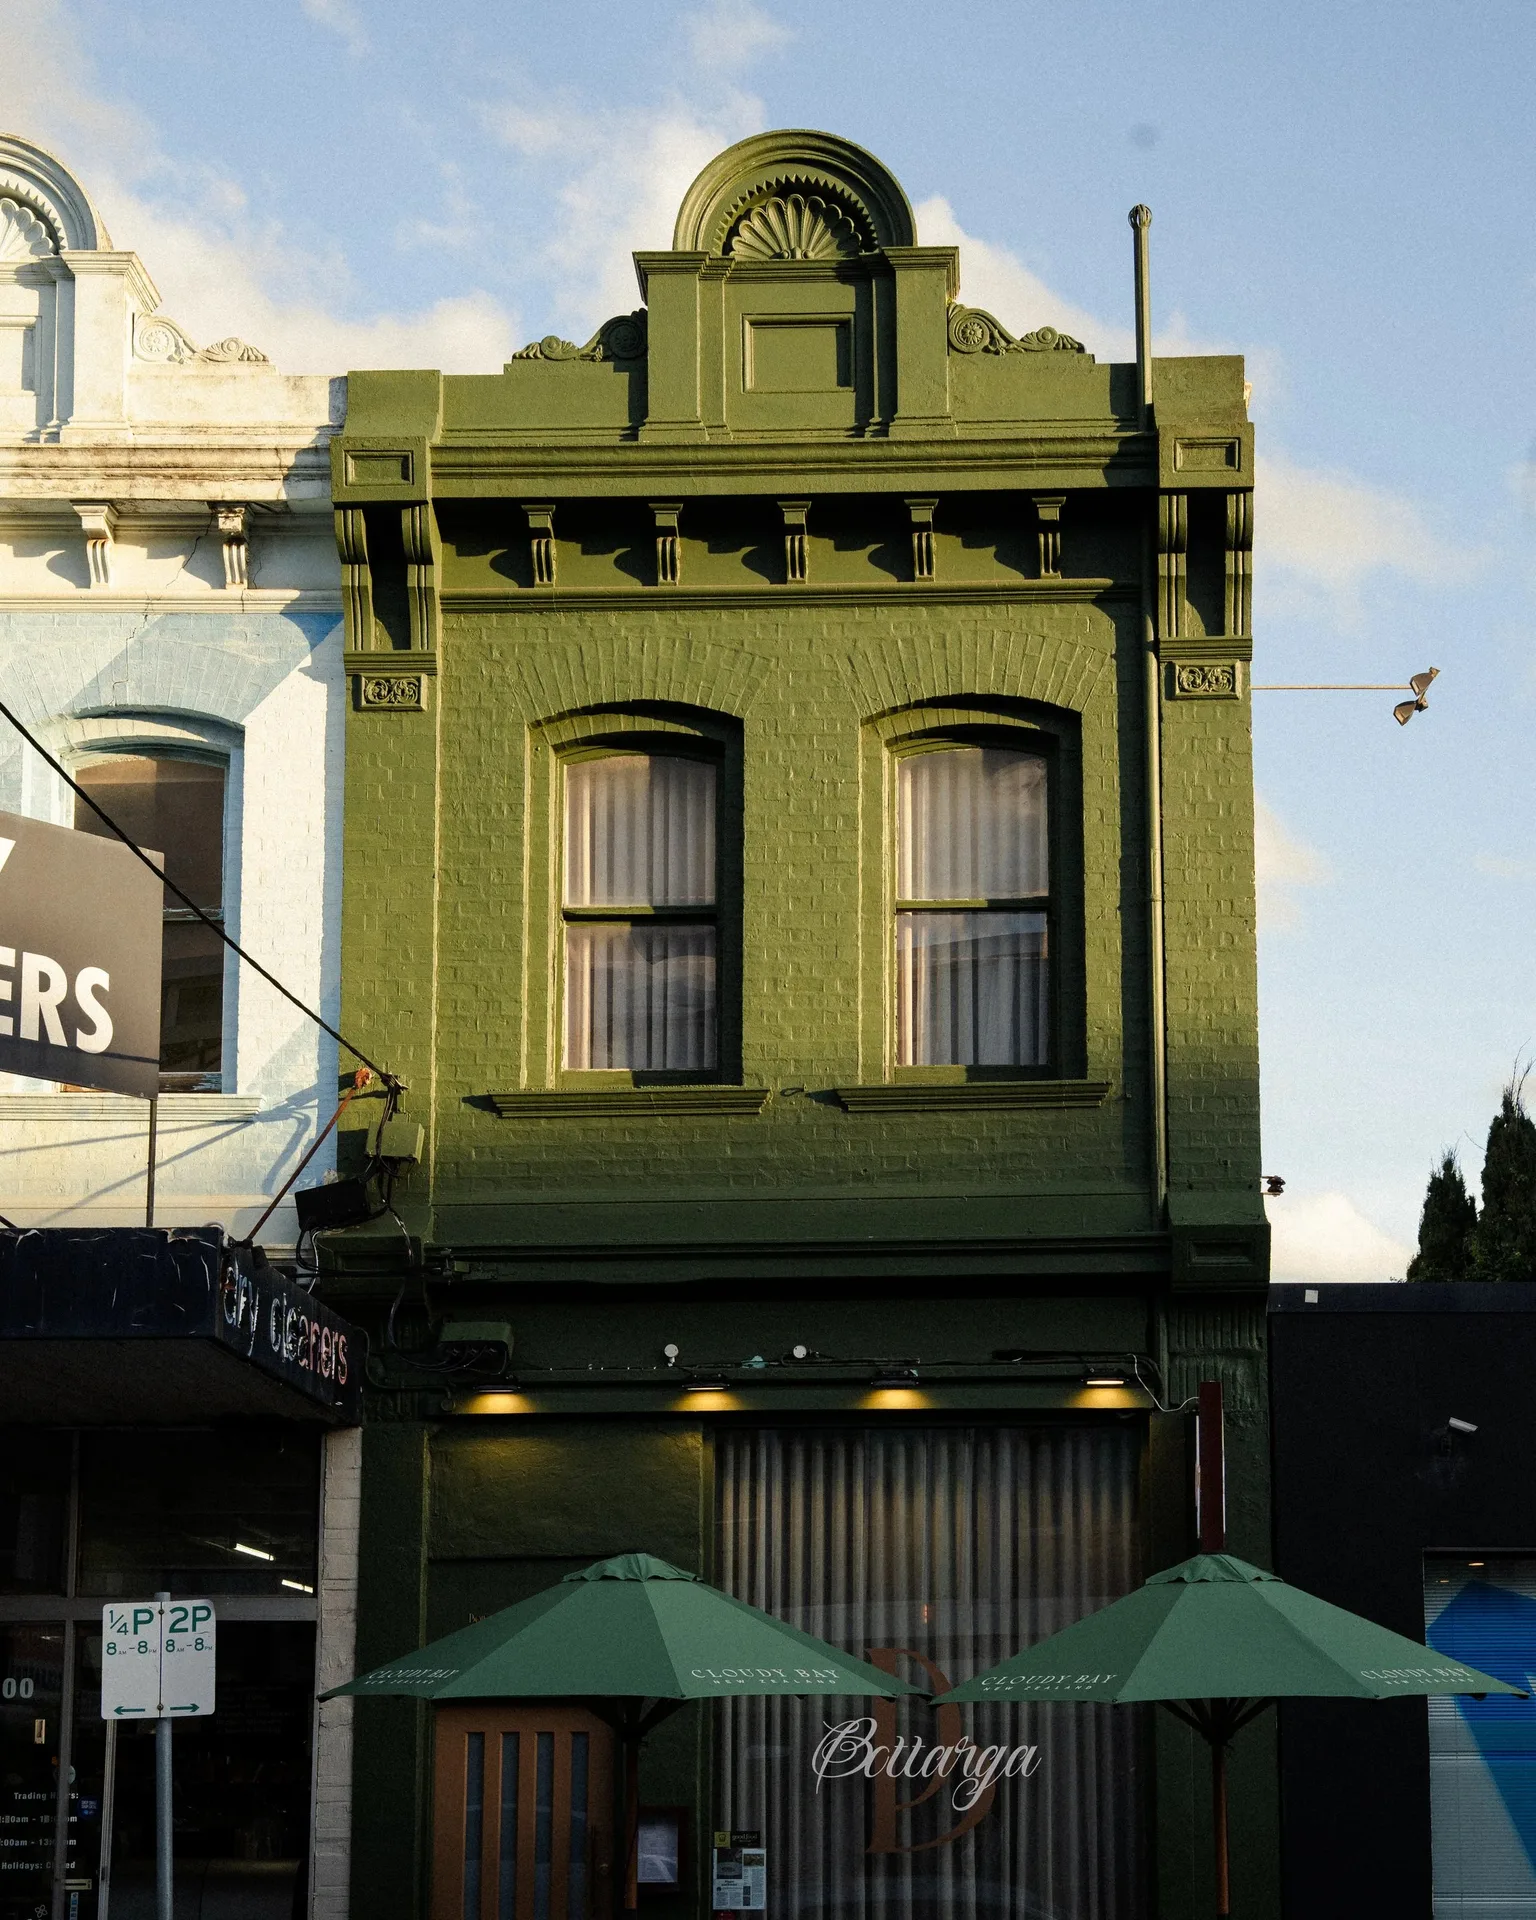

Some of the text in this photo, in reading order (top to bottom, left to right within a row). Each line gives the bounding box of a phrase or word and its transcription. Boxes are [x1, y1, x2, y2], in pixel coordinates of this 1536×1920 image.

[270, 1292, 348, 1385] cleaners
[169, 1605, 212, 1633] 2P
[427, 1669, 459, 1679] BAY
[691, 1668, 840, 1679] CLOUDY BAY
[1360, 1667, 1473, 1680] CLOUDY BAY
[981, 1674, 1118, 1686] CLOUDY BAY
[811, 1717, 1042, 1812] Bottarga
[14, 1792, 47, 1802] Trading
[1, 1860, 76, 1871] Holidays: Ced
